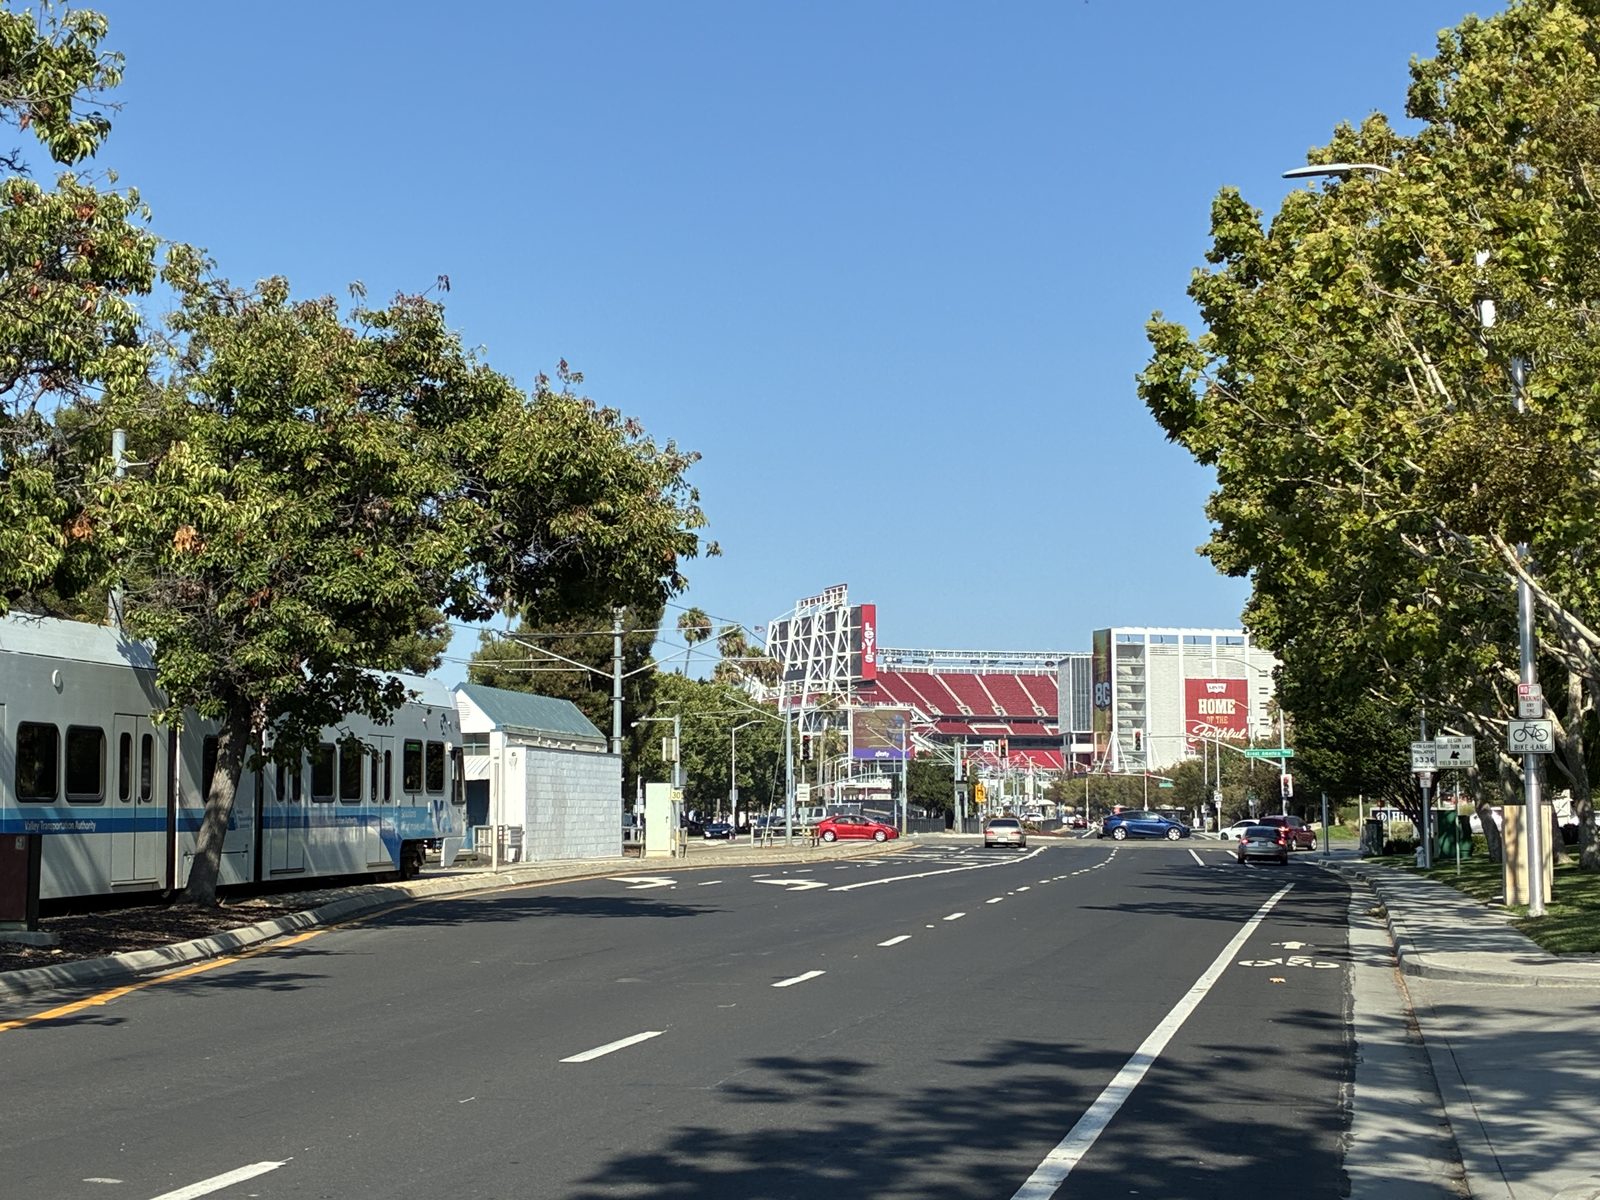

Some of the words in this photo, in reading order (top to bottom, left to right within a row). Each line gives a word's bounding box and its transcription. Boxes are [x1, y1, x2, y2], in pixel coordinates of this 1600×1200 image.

[1198, 698, 1236, 715] HOME
[1206, 716, 1215, 724] OF
[1216, 716, 1229, 725] THE
[1514, 743, 1528, 751] BIKE
[1531, 743, 1549, 751] LANE
[672, 791, 681, 799] 30
[25, 820, 39, 832] Valley
[40, 820, 75, 832] Transportation
[75, 819, 97, 832] Authority
